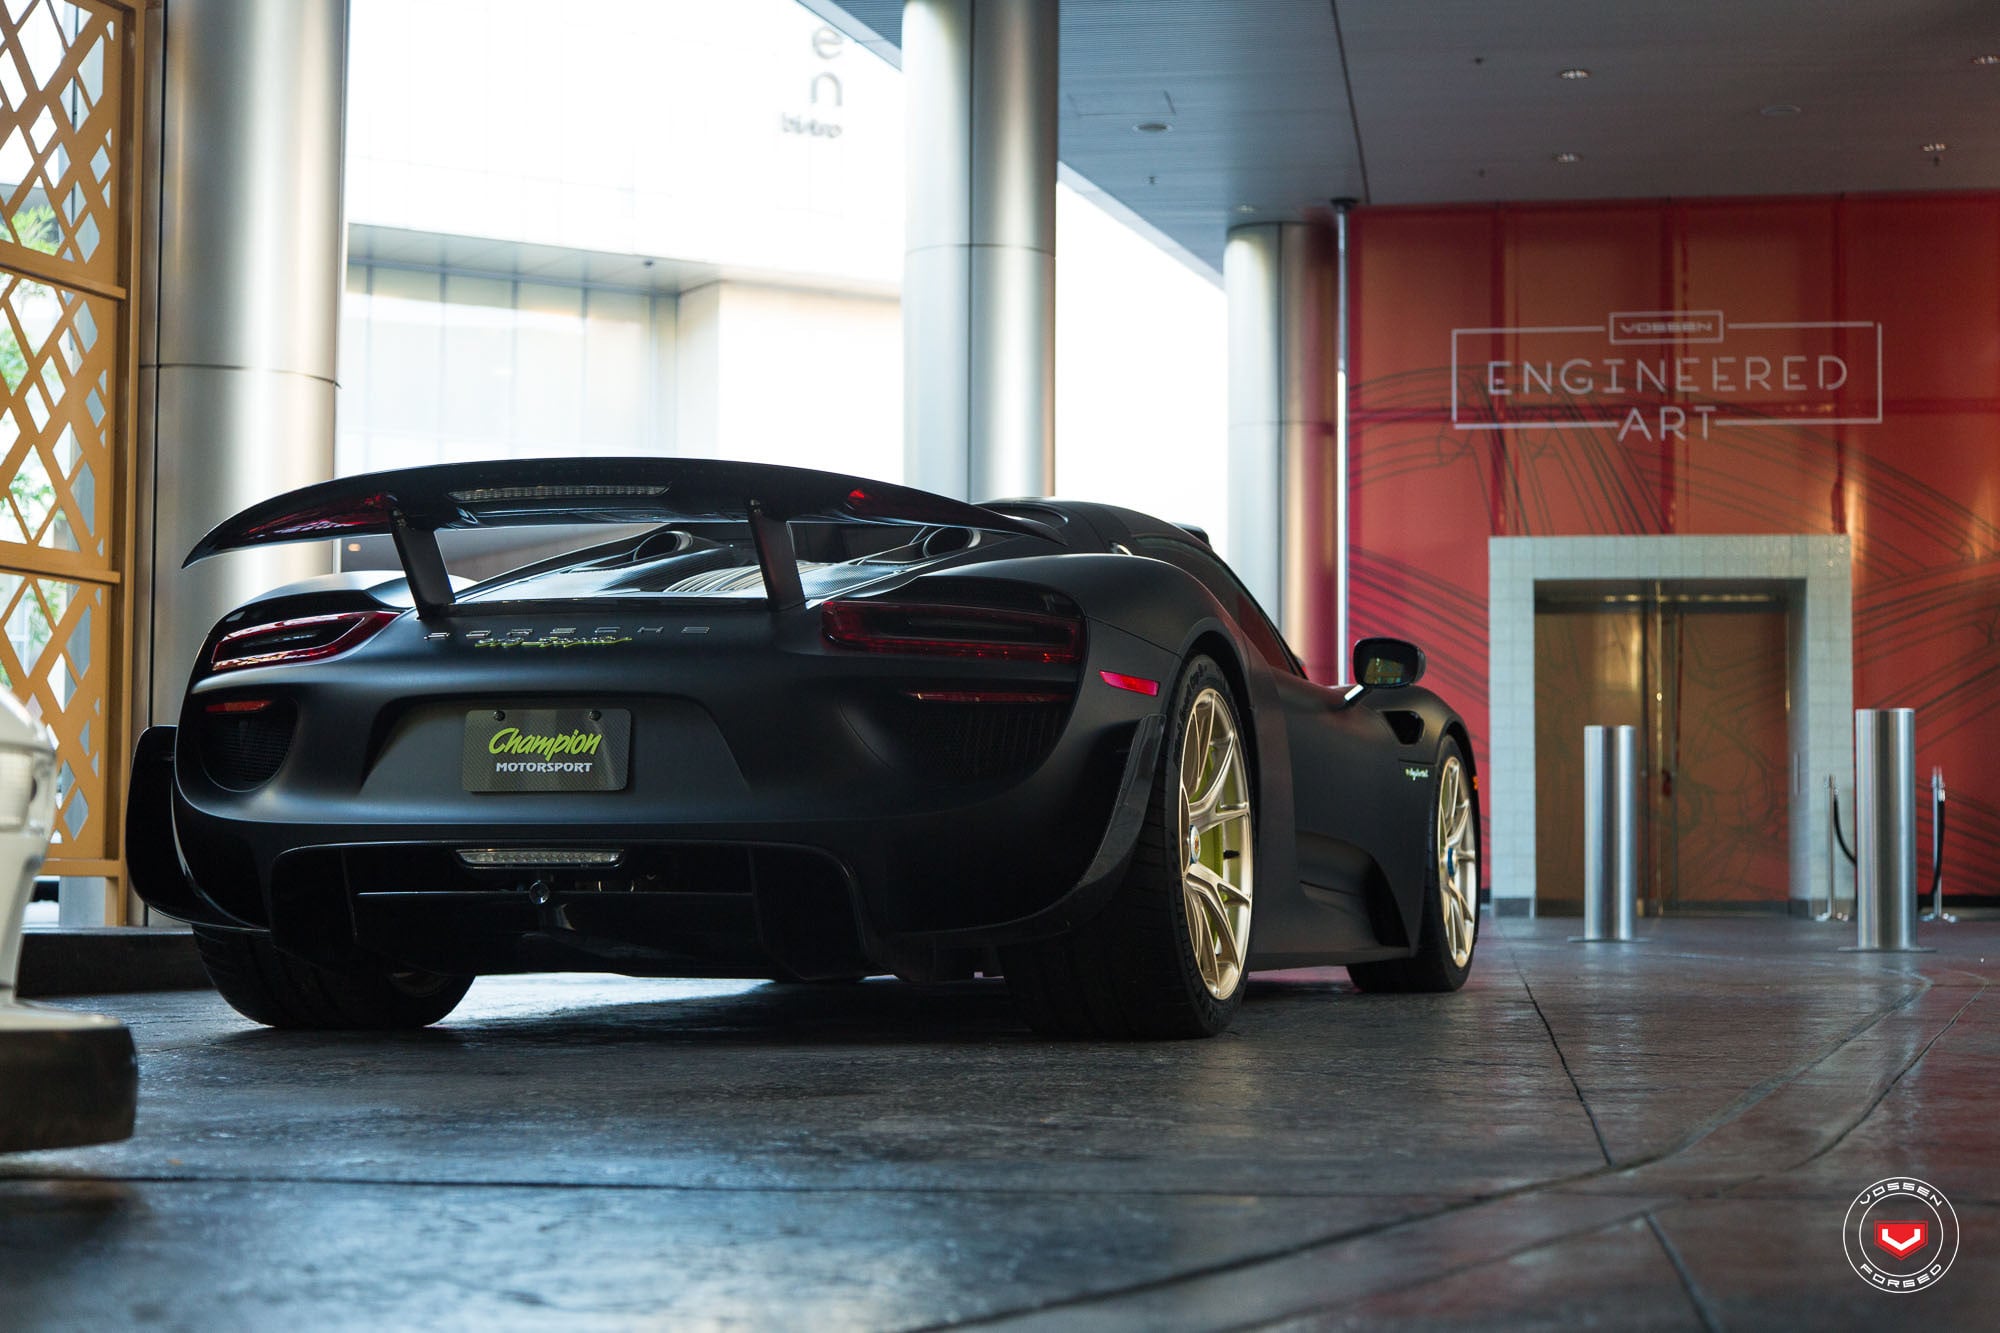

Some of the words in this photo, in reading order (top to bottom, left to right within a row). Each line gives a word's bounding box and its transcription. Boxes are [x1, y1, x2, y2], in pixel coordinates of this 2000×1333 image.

[1620, 321, 1713, 334] VOSSEN
[1487, 354, 1848, 396] ENGINEERED
[1617, 405, 1717, 441] ART
[423, 626, 711, 640] PORSCHE
[488, 727, 602, 761] Champion
[496, 762, 593, 773] MOTORSPORT
